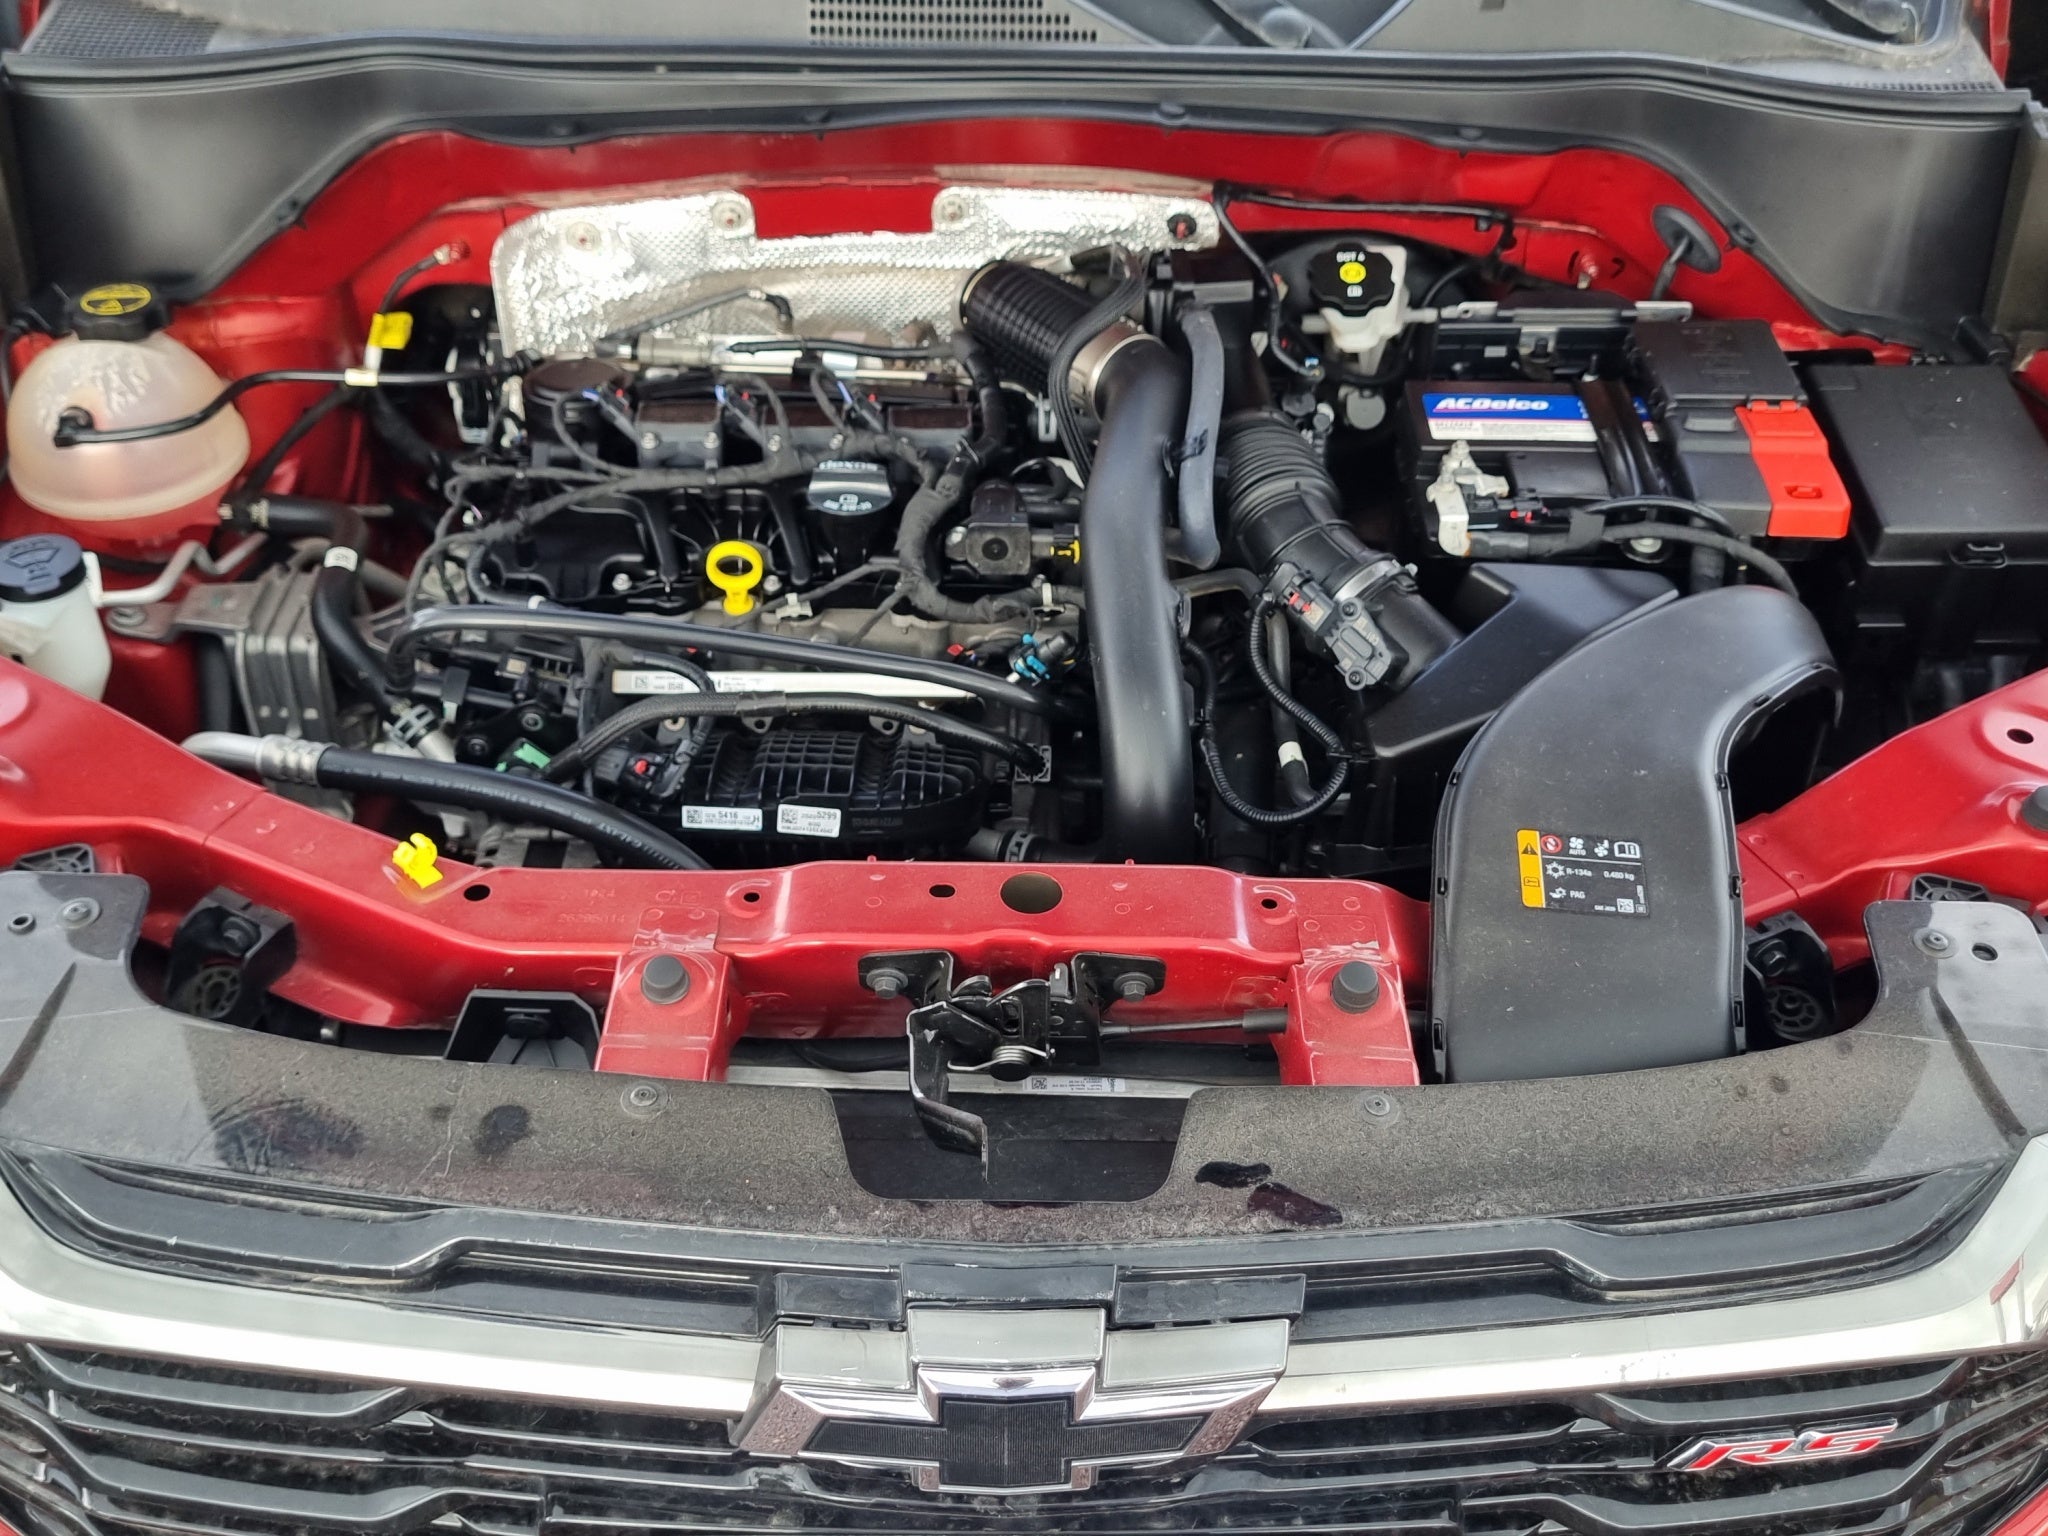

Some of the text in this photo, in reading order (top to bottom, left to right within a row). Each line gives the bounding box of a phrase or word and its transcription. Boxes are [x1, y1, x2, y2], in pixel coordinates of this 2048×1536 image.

[1336, 251, 1357, 263] DOT
[1433, 397, 1549, 412] ACDelco
[718, 811, 738, 820] 5416
[1566, 868, 1593, 877] R-134a
[1624, 872, 1635, 882] kg
[1570, 890, 1586, 899] PAG
[1667, 1417, 1898, 1471] RS
